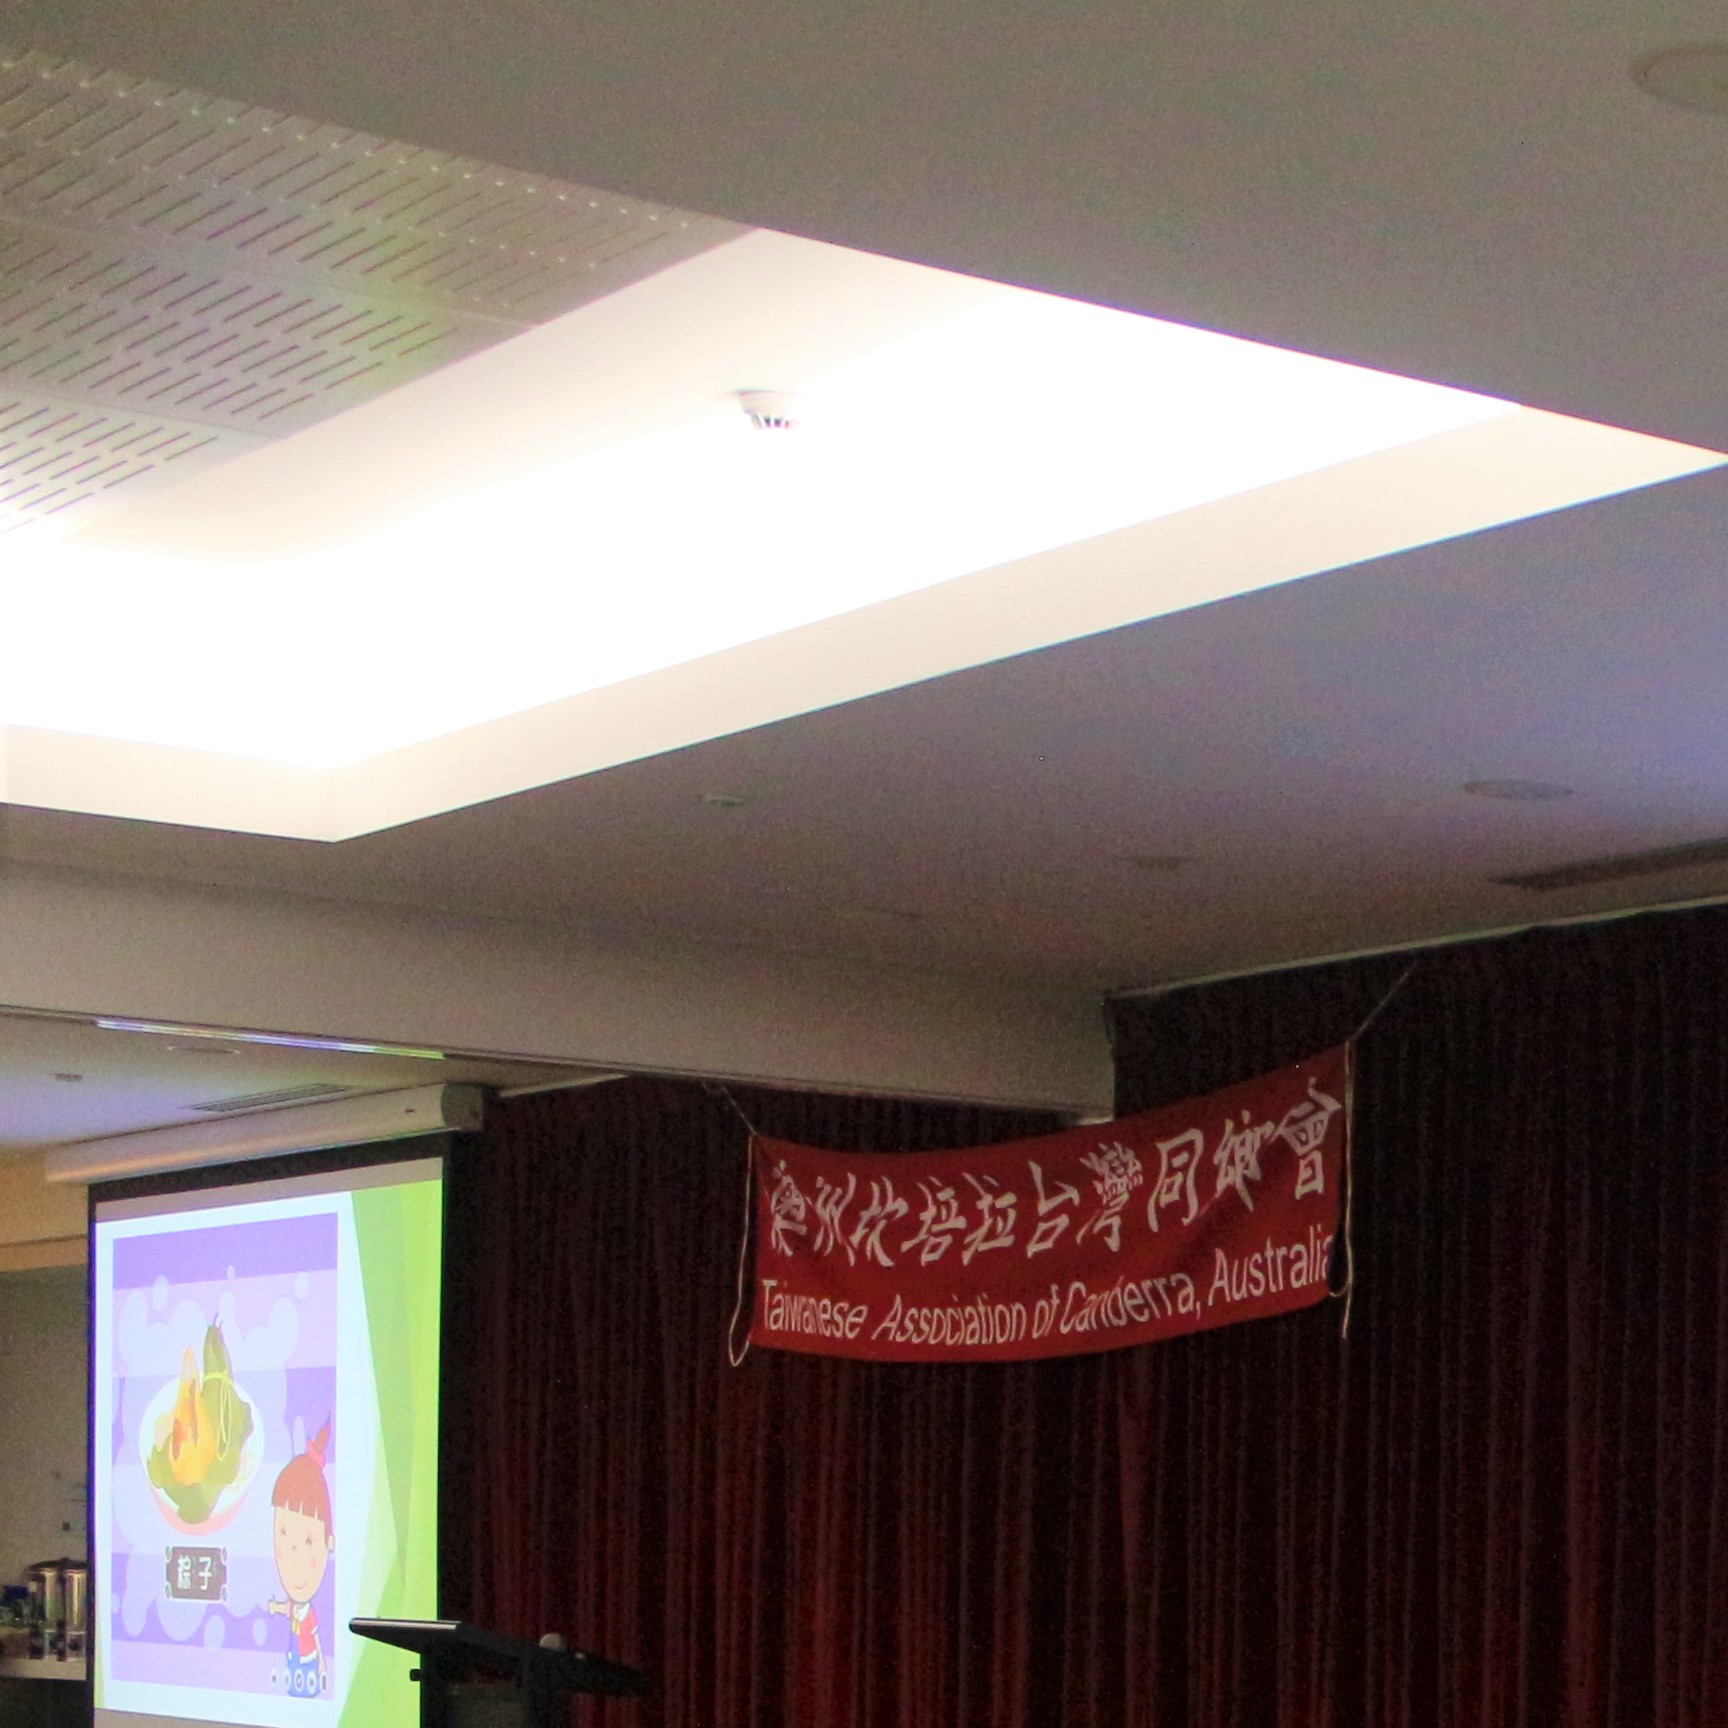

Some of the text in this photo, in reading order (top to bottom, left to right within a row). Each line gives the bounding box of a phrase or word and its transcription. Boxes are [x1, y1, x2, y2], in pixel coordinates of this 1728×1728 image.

[762, 1278, 869, 1341] Taiwanese
[871, 1293, 1028, 1346] Association
[1031, 1283, 1060, 1339] of
[1058, 1272, 1201, 1334] Canberra,
